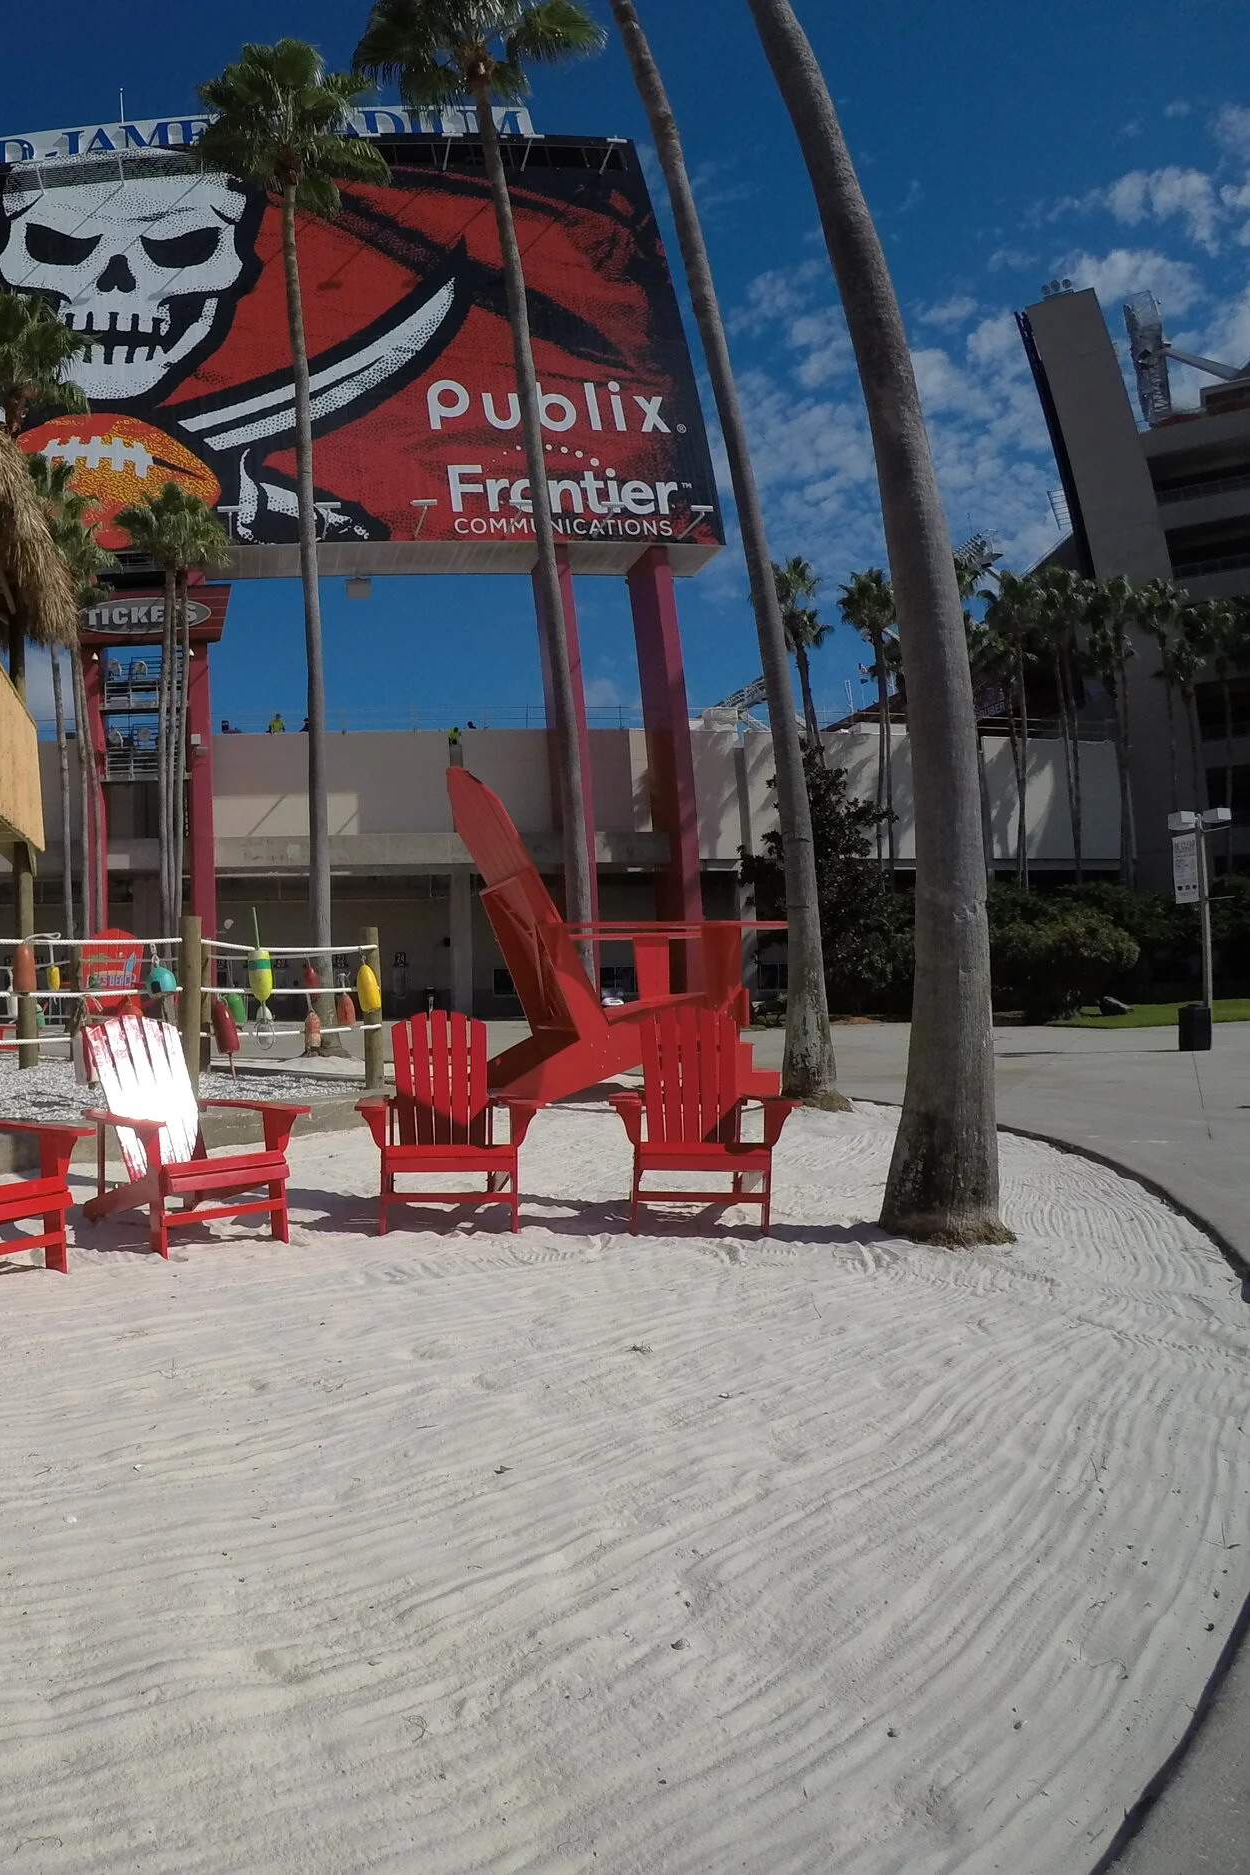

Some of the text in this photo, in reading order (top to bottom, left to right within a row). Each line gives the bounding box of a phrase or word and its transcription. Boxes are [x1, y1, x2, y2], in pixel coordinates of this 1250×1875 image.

[46, 118, 212, 157] JAME
[426, 379, 672, 433] Publix
[447, 464, 678, 515] Frontier
[86, 604, 198, 626] TICKES
